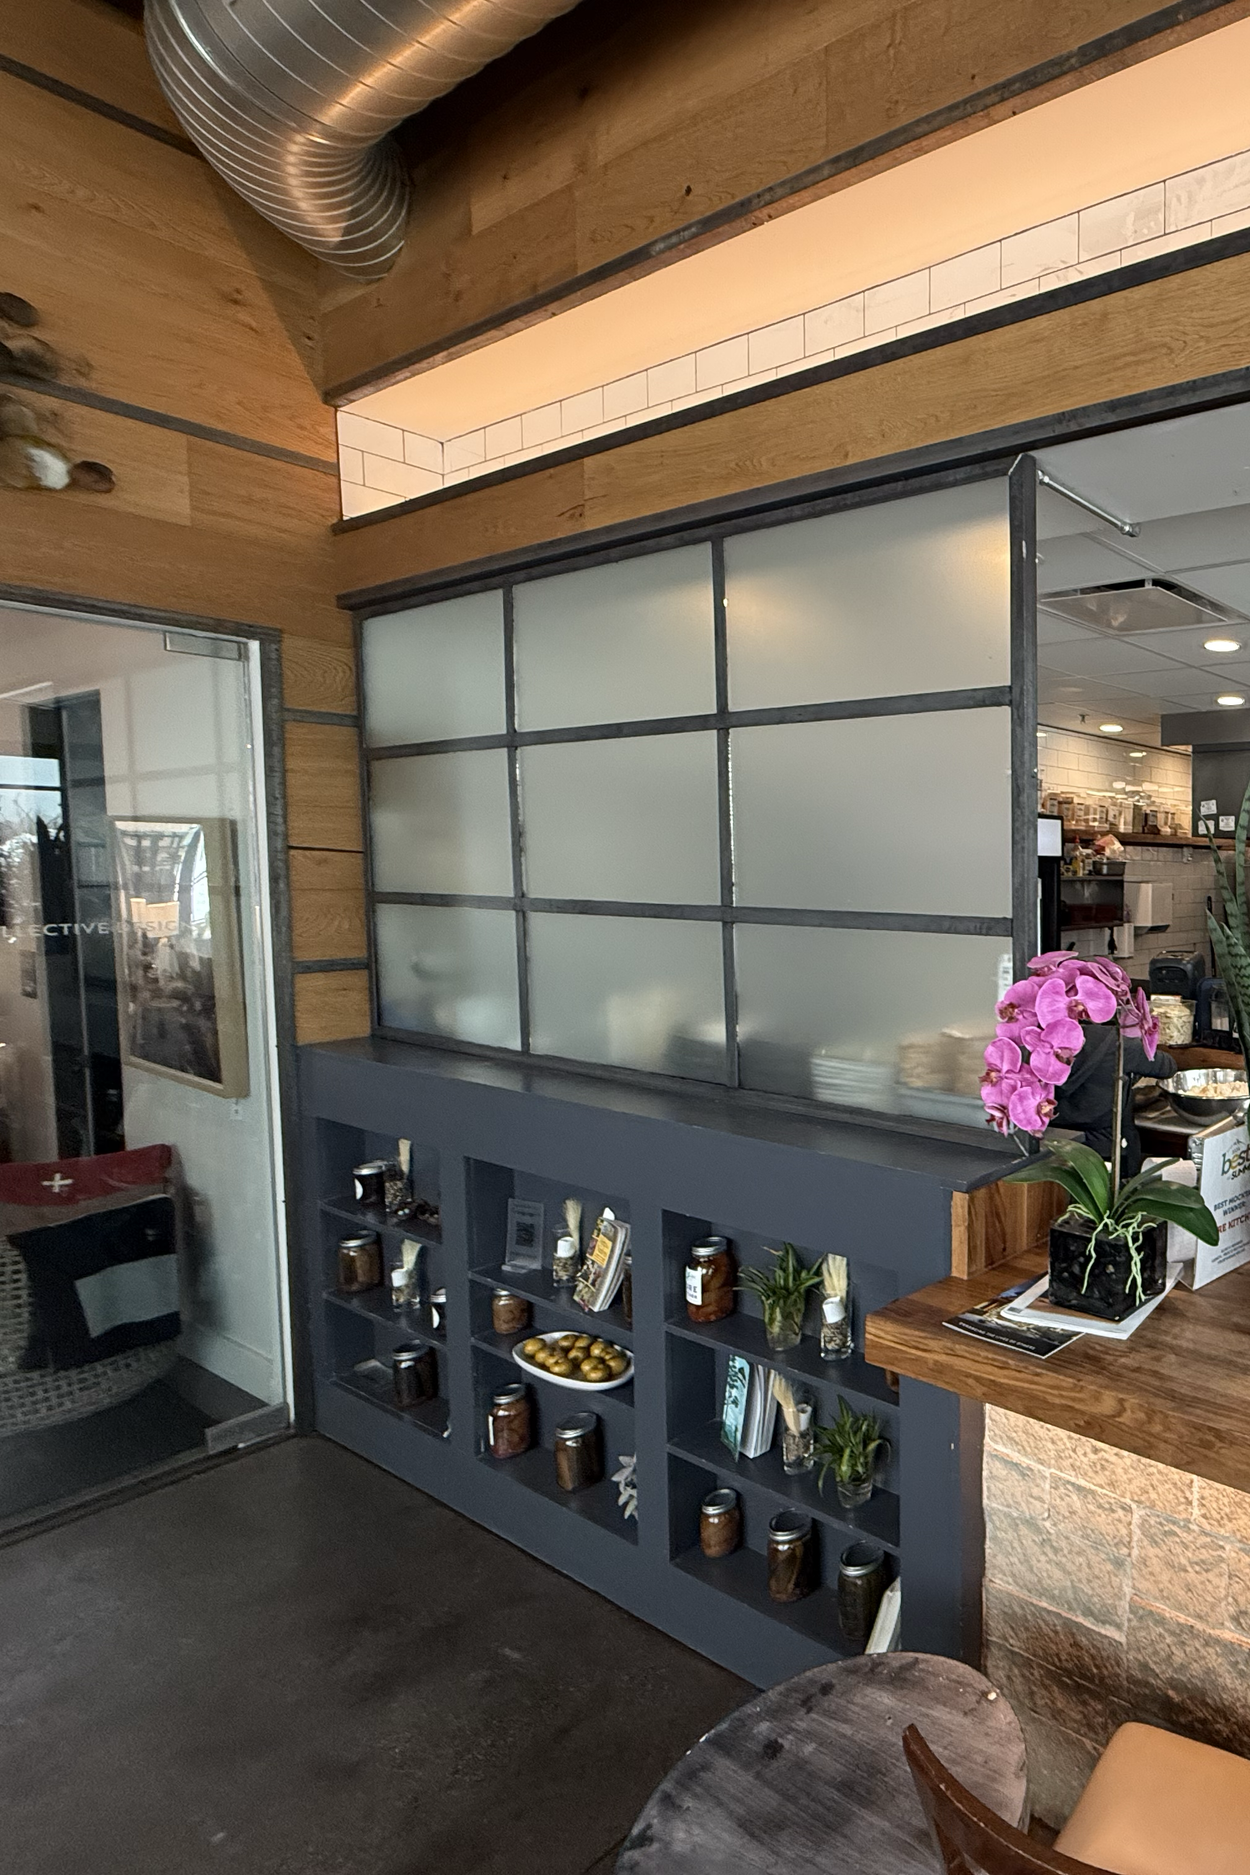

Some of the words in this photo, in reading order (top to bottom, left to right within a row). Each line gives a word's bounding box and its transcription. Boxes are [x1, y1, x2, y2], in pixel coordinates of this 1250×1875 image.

[1221, 1144, 1250, 1176] best
[1214, 1199, 1228, 1212] BEST
[1217, 1223, 1227, 1233] RE
